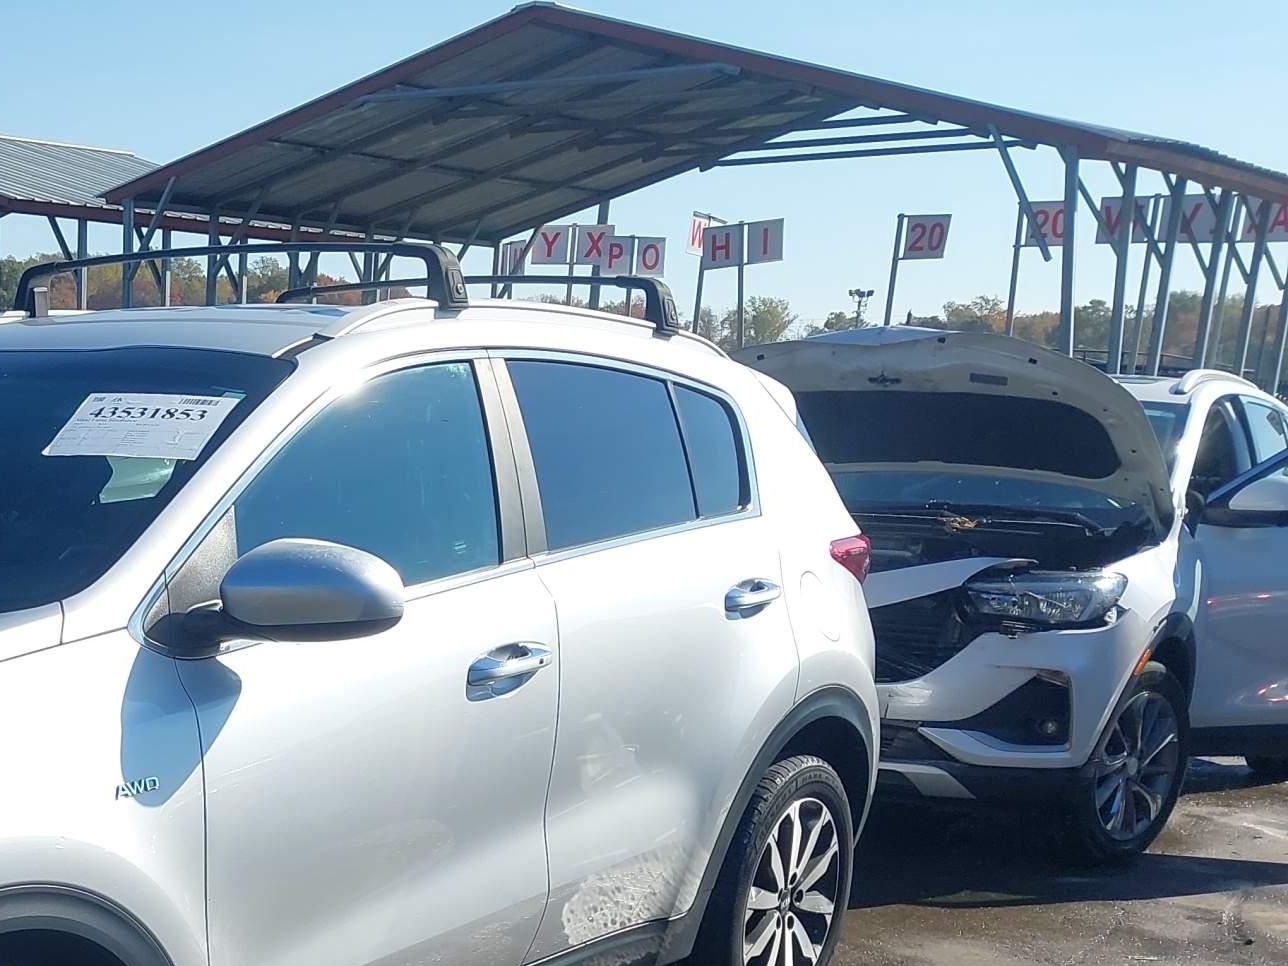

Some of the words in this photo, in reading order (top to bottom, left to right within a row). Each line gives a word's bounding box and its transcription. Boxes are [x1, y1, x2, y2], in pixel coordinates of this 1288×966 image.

[907, 222, 945, 252] 20
[1030, 207, 1065, 239] 20
[540, 231, 561, 258] Y
[583, 231, 606, 258] X
[607, 242, 624, 270] P
[641, 243, 660, 271] O
[711, 232, 731, 262] H
[761, 227, 769, 256] I
[89, 405, 209, 422] 43531853
[115, 776, 160, 800] AWD
